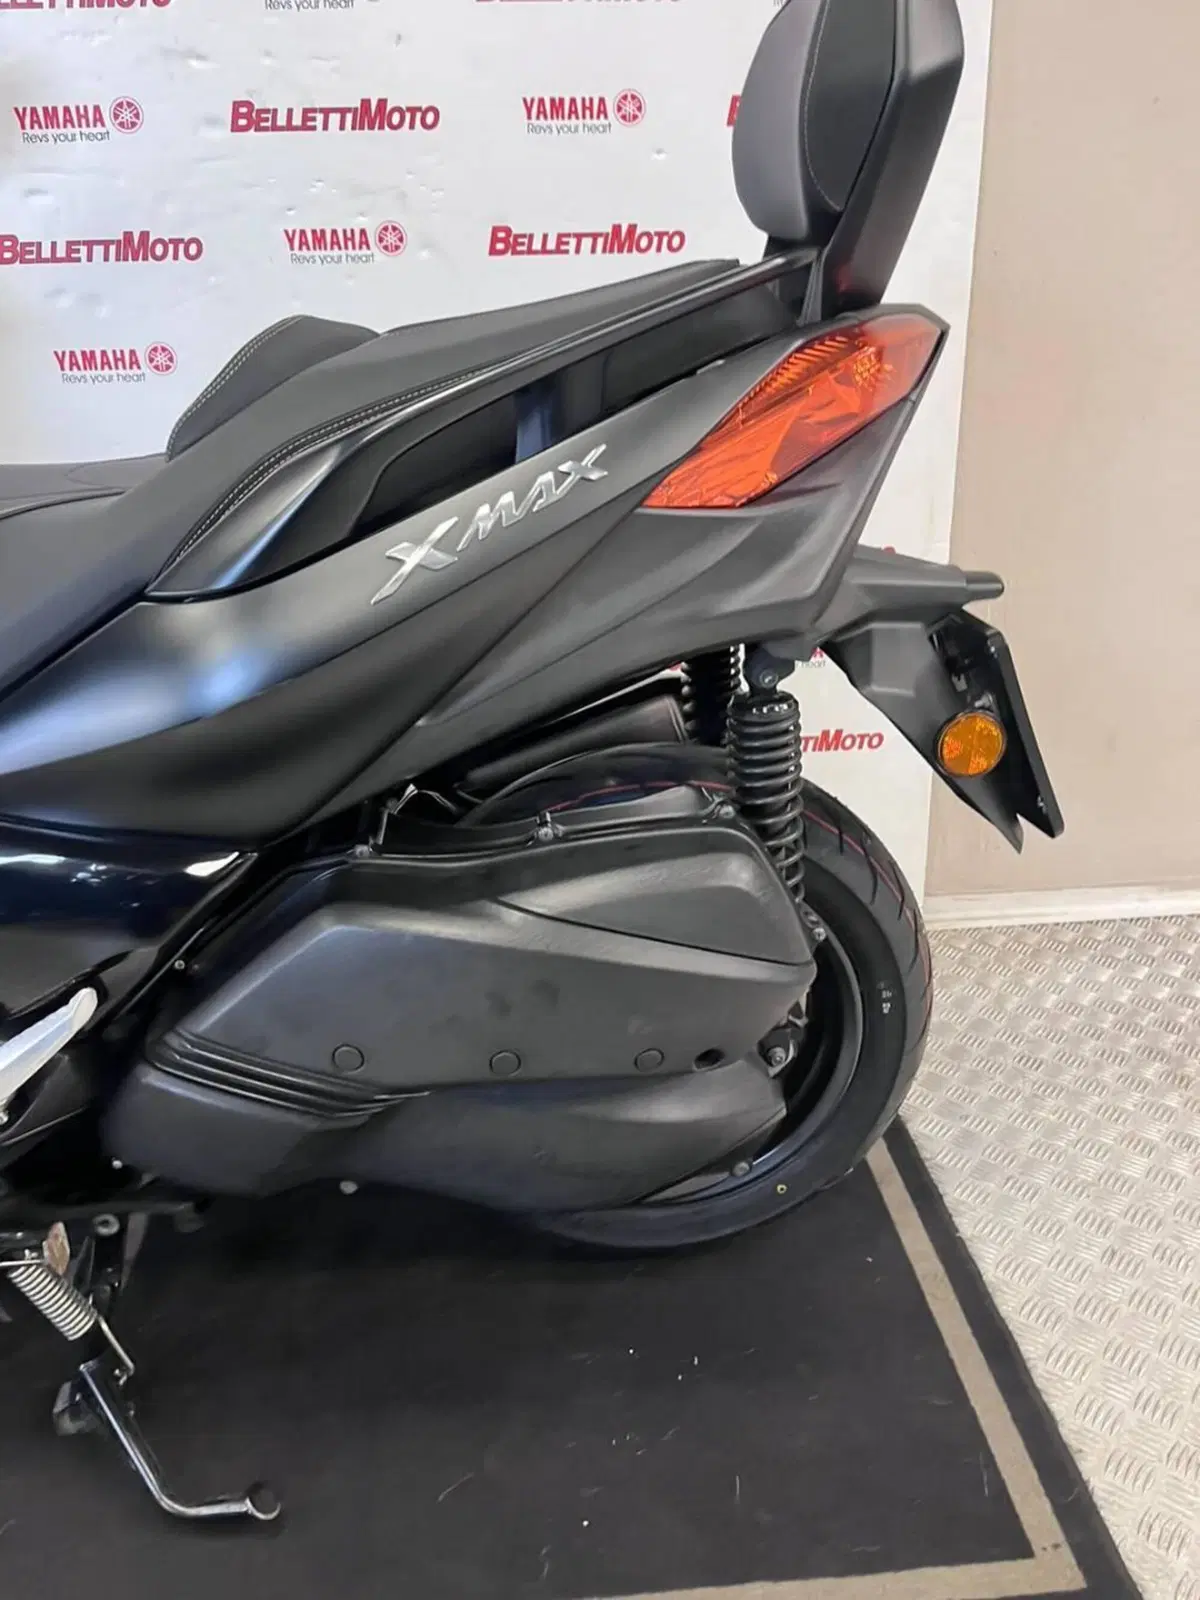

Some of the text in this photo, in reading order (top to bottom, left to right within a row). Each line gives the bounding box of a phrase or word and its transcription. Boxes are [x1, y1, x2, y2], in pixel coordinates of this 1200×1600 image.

[265, 0, 292, 9] Revs
[295, 0, 319, 11] your
[523, 97, 608, 120] YAMAHA
[13, 104, 106, 130] YAMAHA
[527, 122, 611, 136] Revs your heart
[22, 130, 110, 144] Revs your heart
[284, 228, 371, 251] YAMAHA
[290, 252, 374, 265] Revs your heart
[53, 349, 141, 371] YAMAHA
[62, 372, 145, 385] Revs your heart
